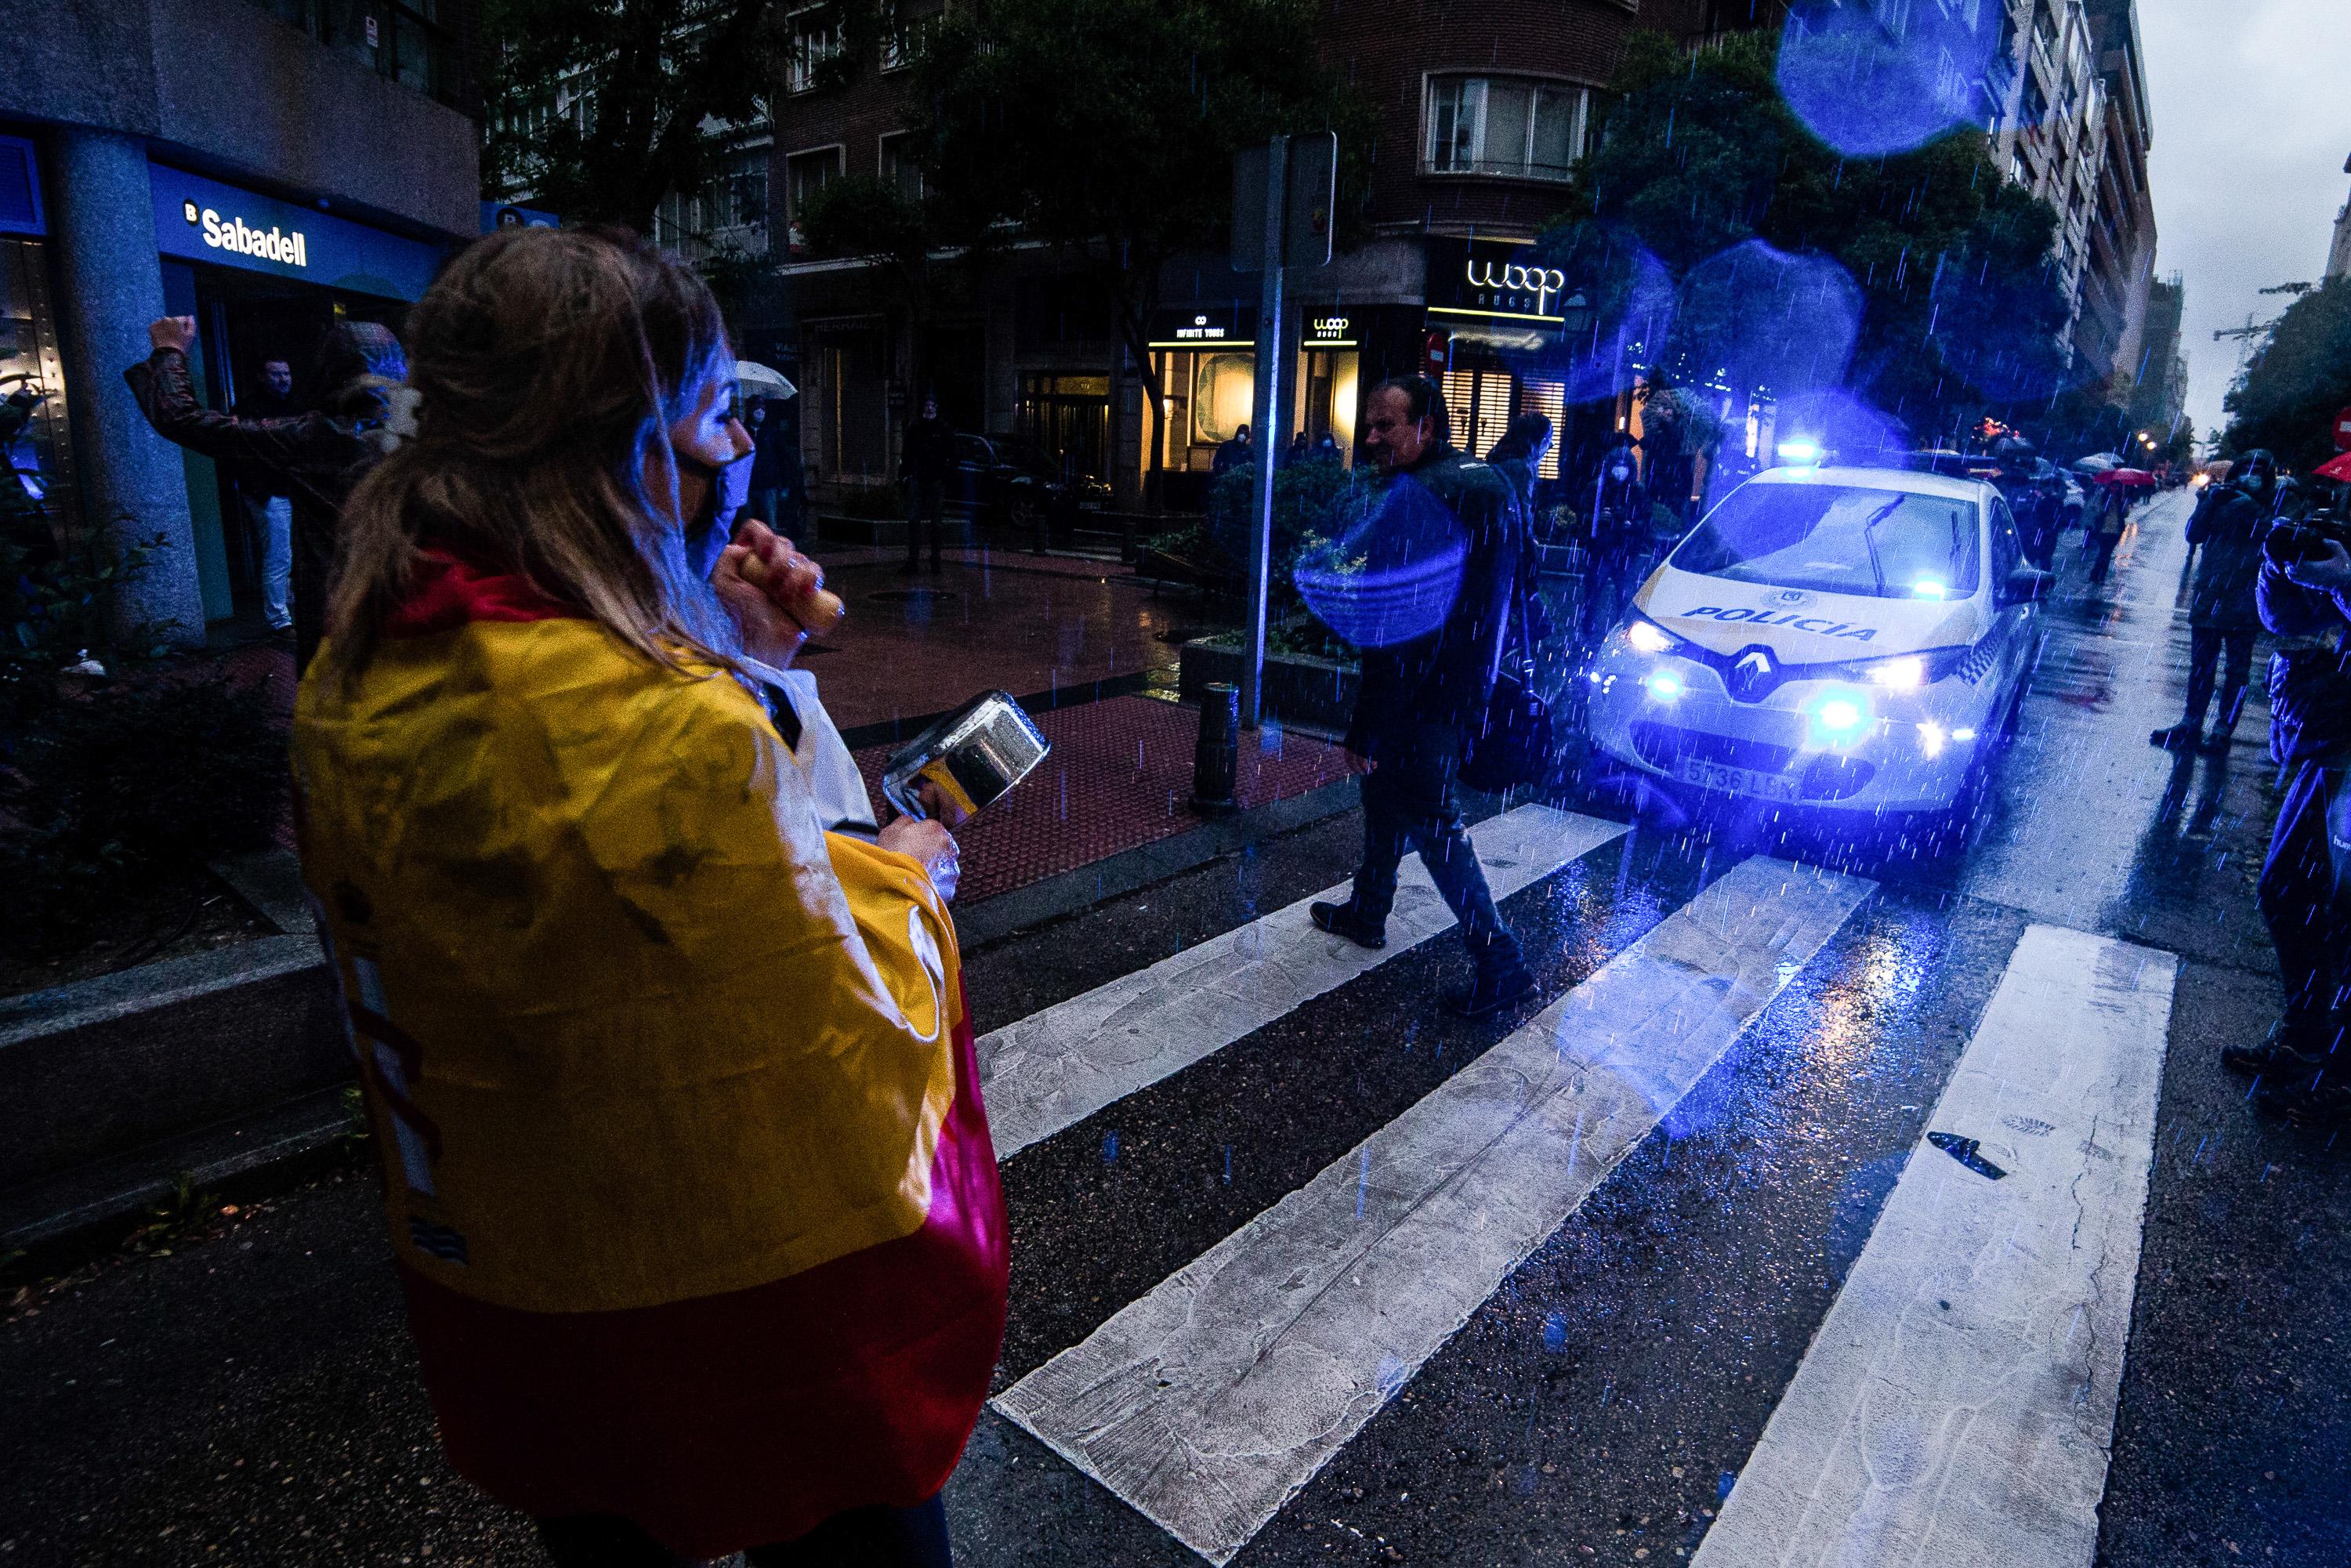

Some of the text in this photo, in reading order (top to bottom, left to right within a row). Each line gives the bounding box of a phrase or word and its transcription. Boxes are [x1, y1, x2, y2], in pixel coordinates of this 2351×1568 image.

[202, 208, 306, 267] Sabadell
[1467, 259, 1565, 315] woop
[1478, 293, 1531, 308] RUGS
[1689, 762, 1742, 790] 5736
